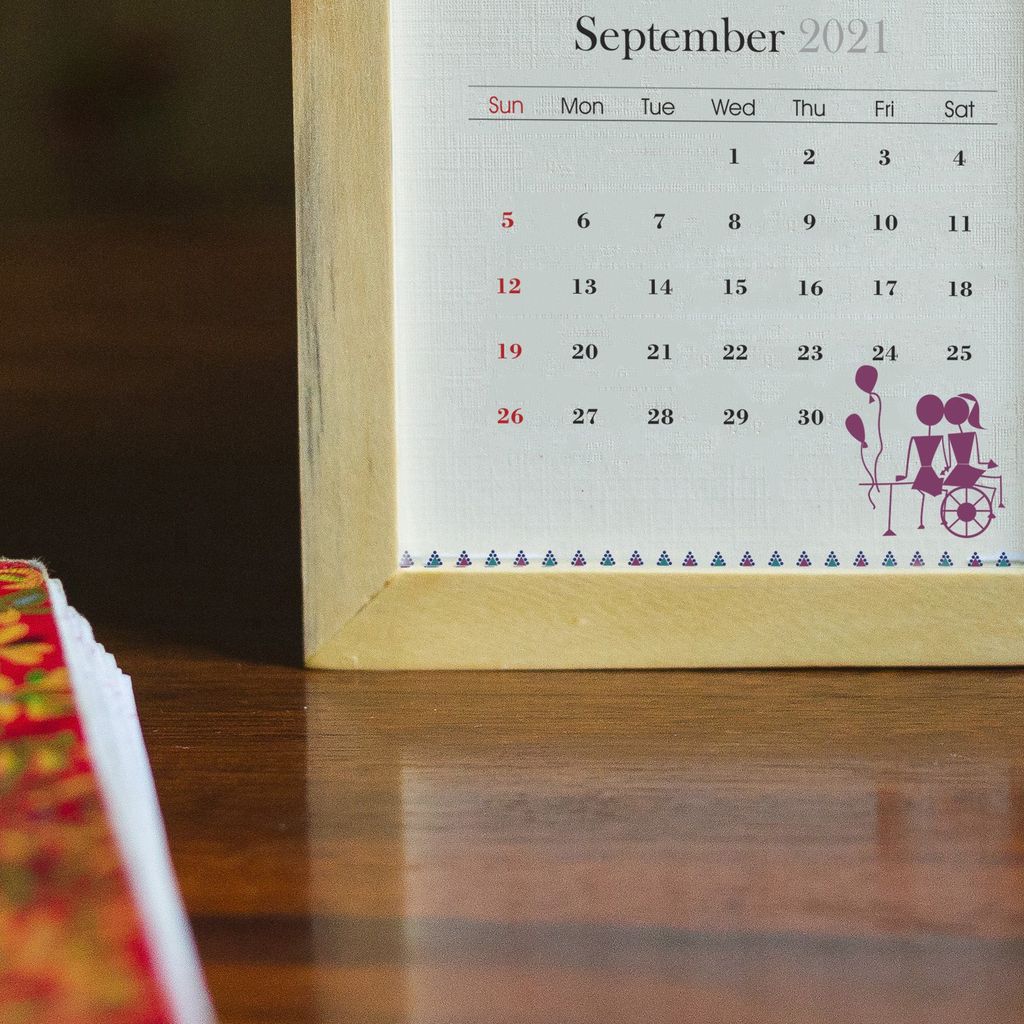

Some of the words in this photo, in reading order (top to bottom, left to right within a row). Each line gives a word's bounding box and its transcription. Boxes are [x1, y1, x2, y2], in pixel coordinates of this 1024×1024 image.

[574, 14, 786, 61] September
[798, 18, 888, 55] 2021
[488, 95, 524, 115] Sun
[560, 96, 605, 116] Mon
[640, 97, 676, 116] Tue
[710, 98, 756, 117] Wed
[792, 98, 826, 118] Thu
[874, 99, 895, 118] Fri
[944, 99, 976, 119] Sat
[729, 147, 739, 165] 1
[802, 148, 816, 166] 2
[878, 148, 892, 167] 3
[952, 149, 967, 167] 4
[501, 211, 515, 229] 5
[576, 211, 591, 229] 6
[653, 212, 666, 230] 7
[727, 212, 742, 231] 8
[802, 213, 817, 231] 9
[873, 213, 899, 232] 10
[948, 214, 971, 233] 11
[497, 277, 522, 295] 12
[572, 278, 598, 295] 13
[648, 278, 674, 296] 14
[723, 278, 748, 296] 15
[798, 279, 824, 297] 16
[873, 279, 898, 297] 17
[948, 280, 973, 298] 18
[498, 342, 523, 360] 19
[571, 343, 599, 361] 20
[646, 343, 672, 361] 21
[722, 343, 748, 361] 22
[797, 344, 824, 362] 23
[871, 344, 899, 362] 24
[946, 344, 973, 362] 25
[496, 407, 525, 425] 26
[572, 407, 599, 425] 27
[647, 407, 675, 426] 28
[722, 408, 750, 426] 29
[797, 408, 825, 426] 30
